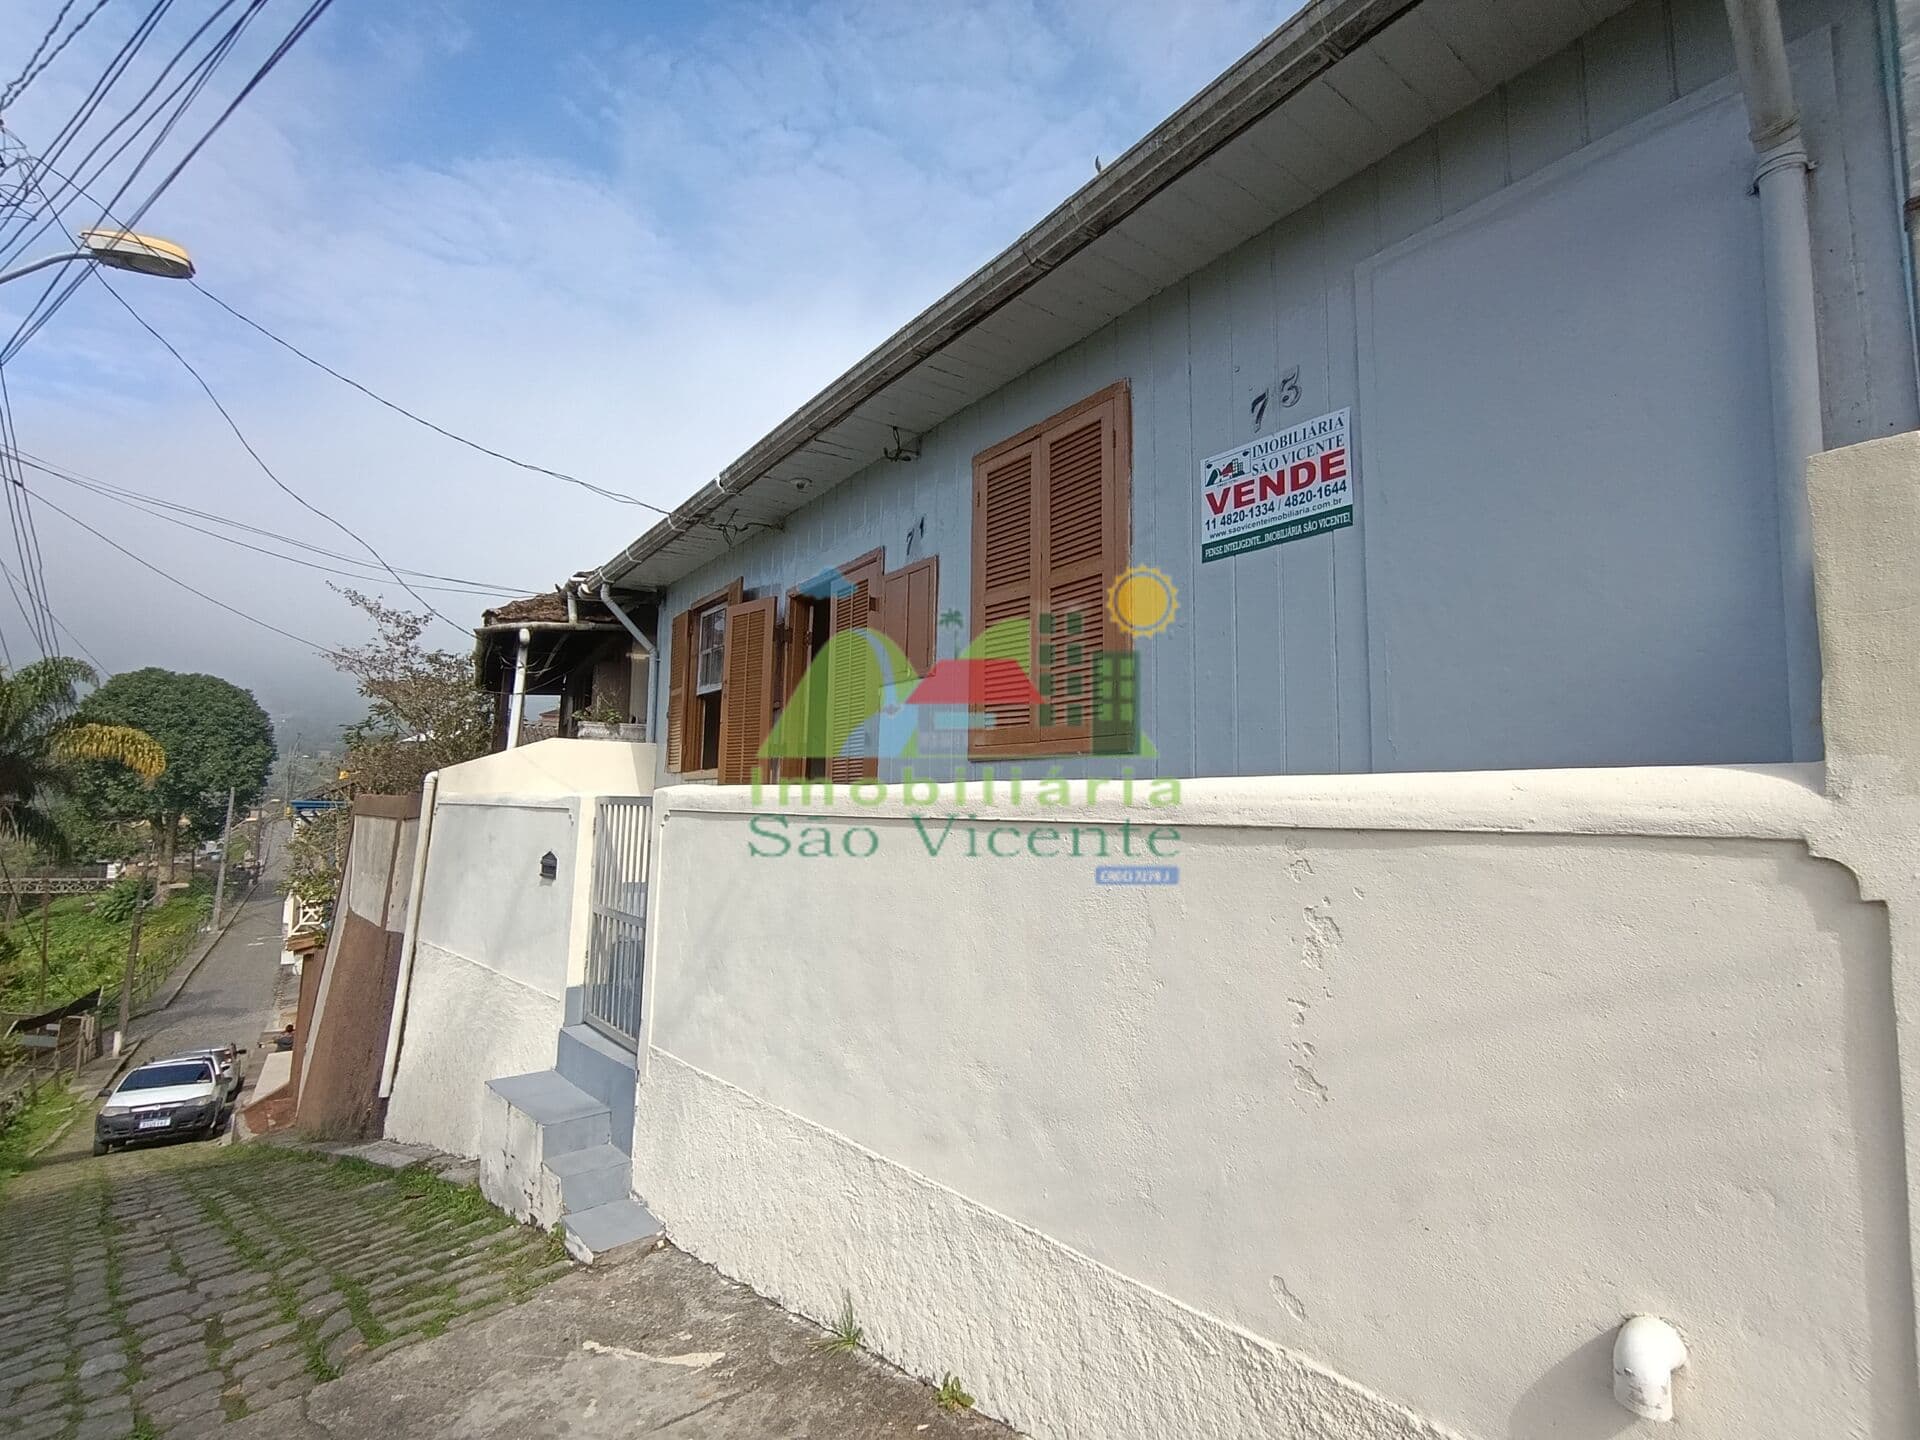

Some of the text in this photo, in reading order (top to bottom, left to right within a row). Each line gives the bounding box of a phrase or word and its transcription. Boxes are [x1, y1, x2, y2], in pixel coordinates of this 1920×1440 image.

[1251, 415, 1345, 459] IMOBILIÁRIA
[1251, 433, 1345, 477] SÃO VICENTE
[1205, 448, 1347, 516] VENDE
[1205, 517, 1217, 532] 11
[1219, 500, 1276, 527] 4820-1334
[1284, 479, 1348, 509] 4820-1644
[1208, 498, 1342, 540] www.saovicenteimobiliaria.com.br
[1302, 519, 1318, 534] SÃO
